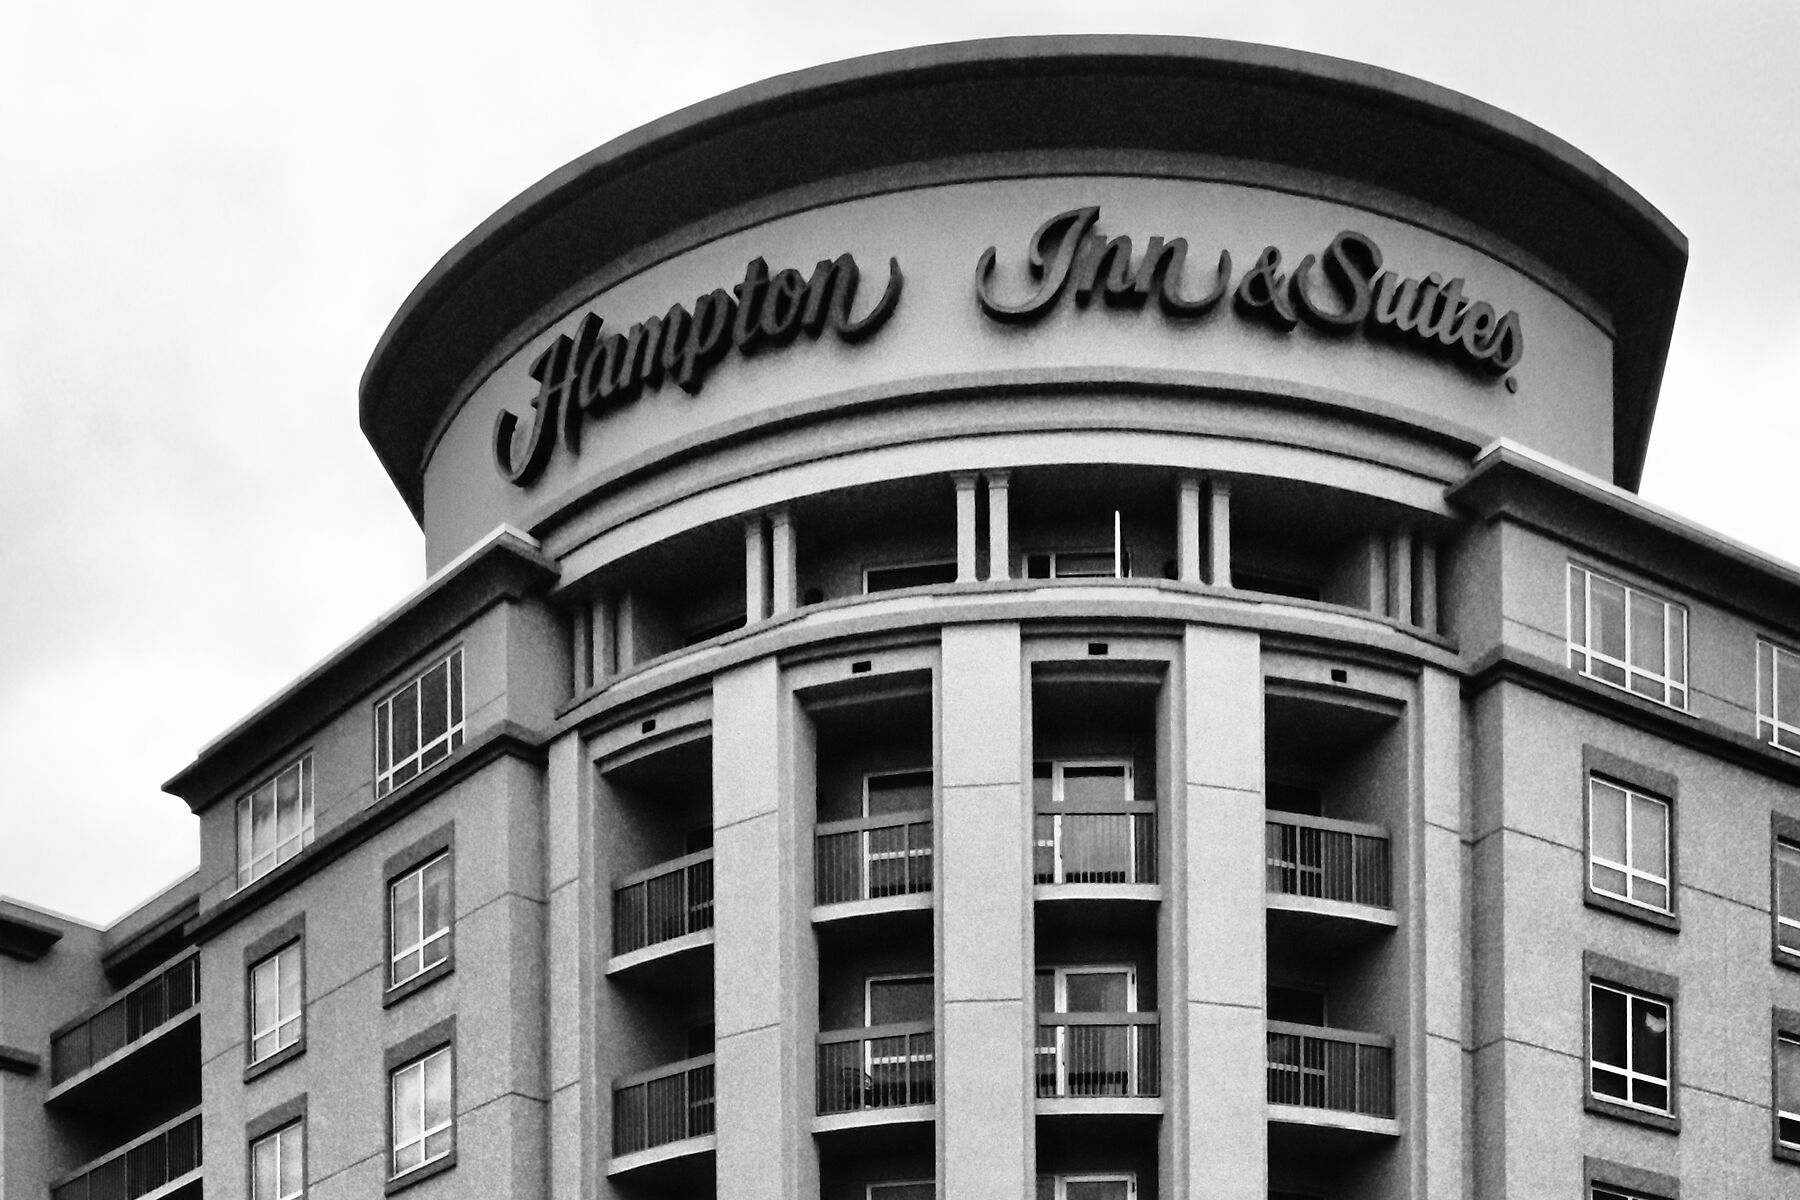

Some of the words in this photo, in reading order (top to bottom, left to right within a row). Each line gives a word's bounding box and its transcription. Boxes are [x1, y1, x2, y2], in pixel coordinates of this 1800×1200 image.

[492, 252, 904, 486] Hampton
[976, 205, 1232, 323] Inn
[1234, 246, 1298, 332] &
[1296, 230, 1526, 382] Suites
